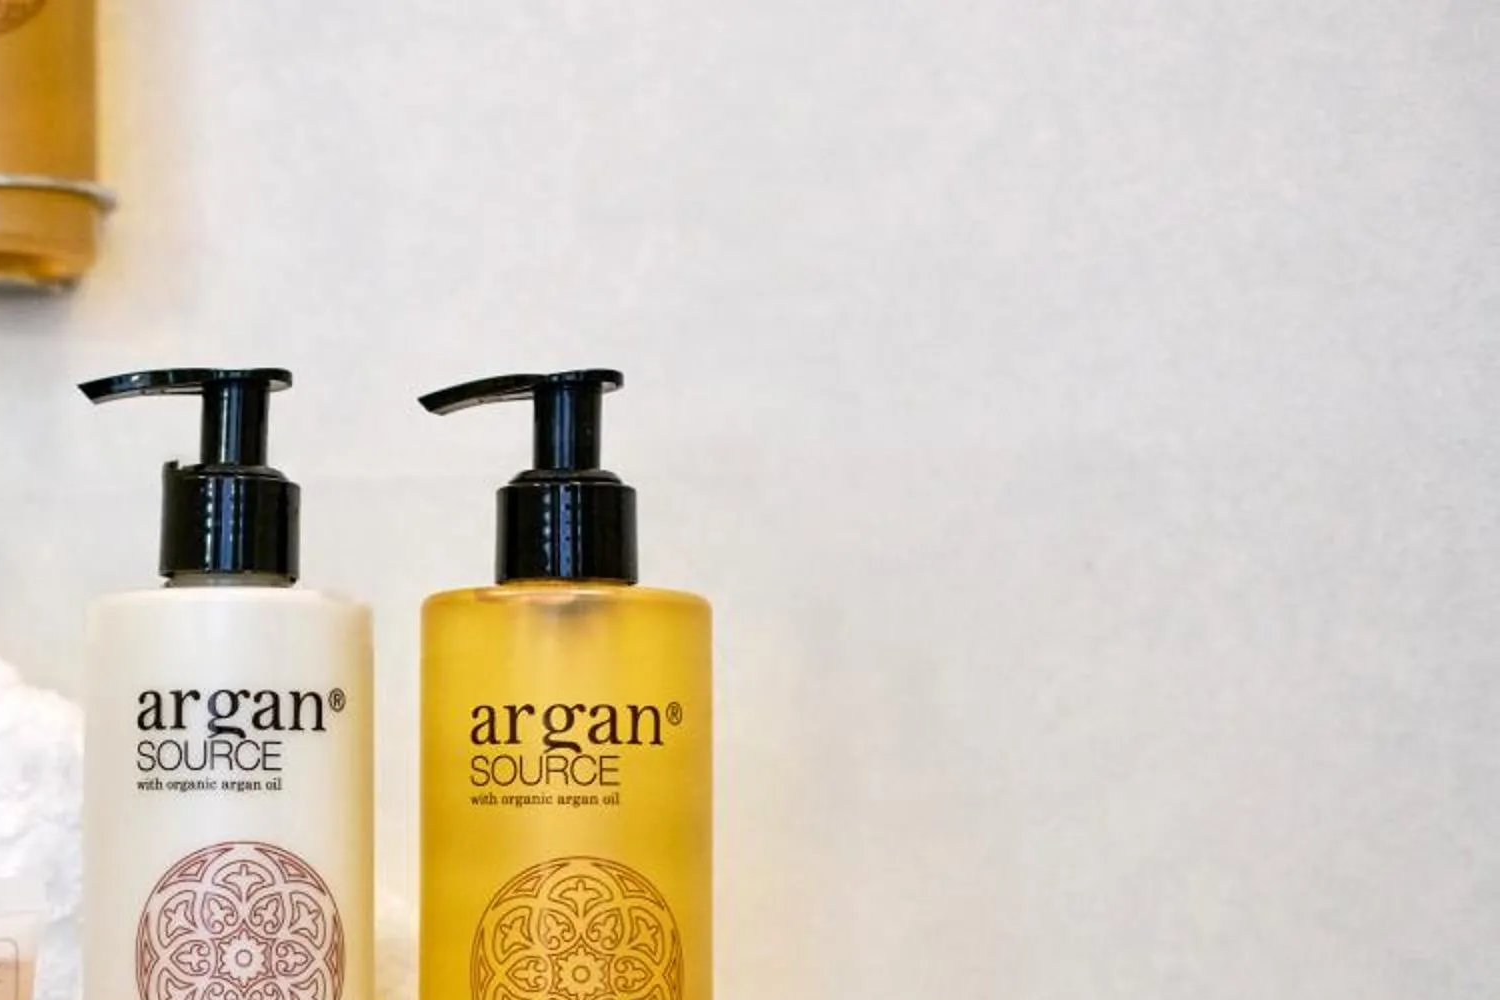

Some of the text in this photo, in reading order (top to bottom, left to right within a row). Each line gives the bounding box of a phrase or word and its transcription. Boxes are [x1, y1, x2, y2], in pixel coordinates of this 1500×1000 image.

[136, 739, 283, 772] SOURCE
[469, 754, 622, 787] SOURCE
[136, 777, 283, 793] with organic argan oil
[469, 791, 621, 809] with organic argan oil
